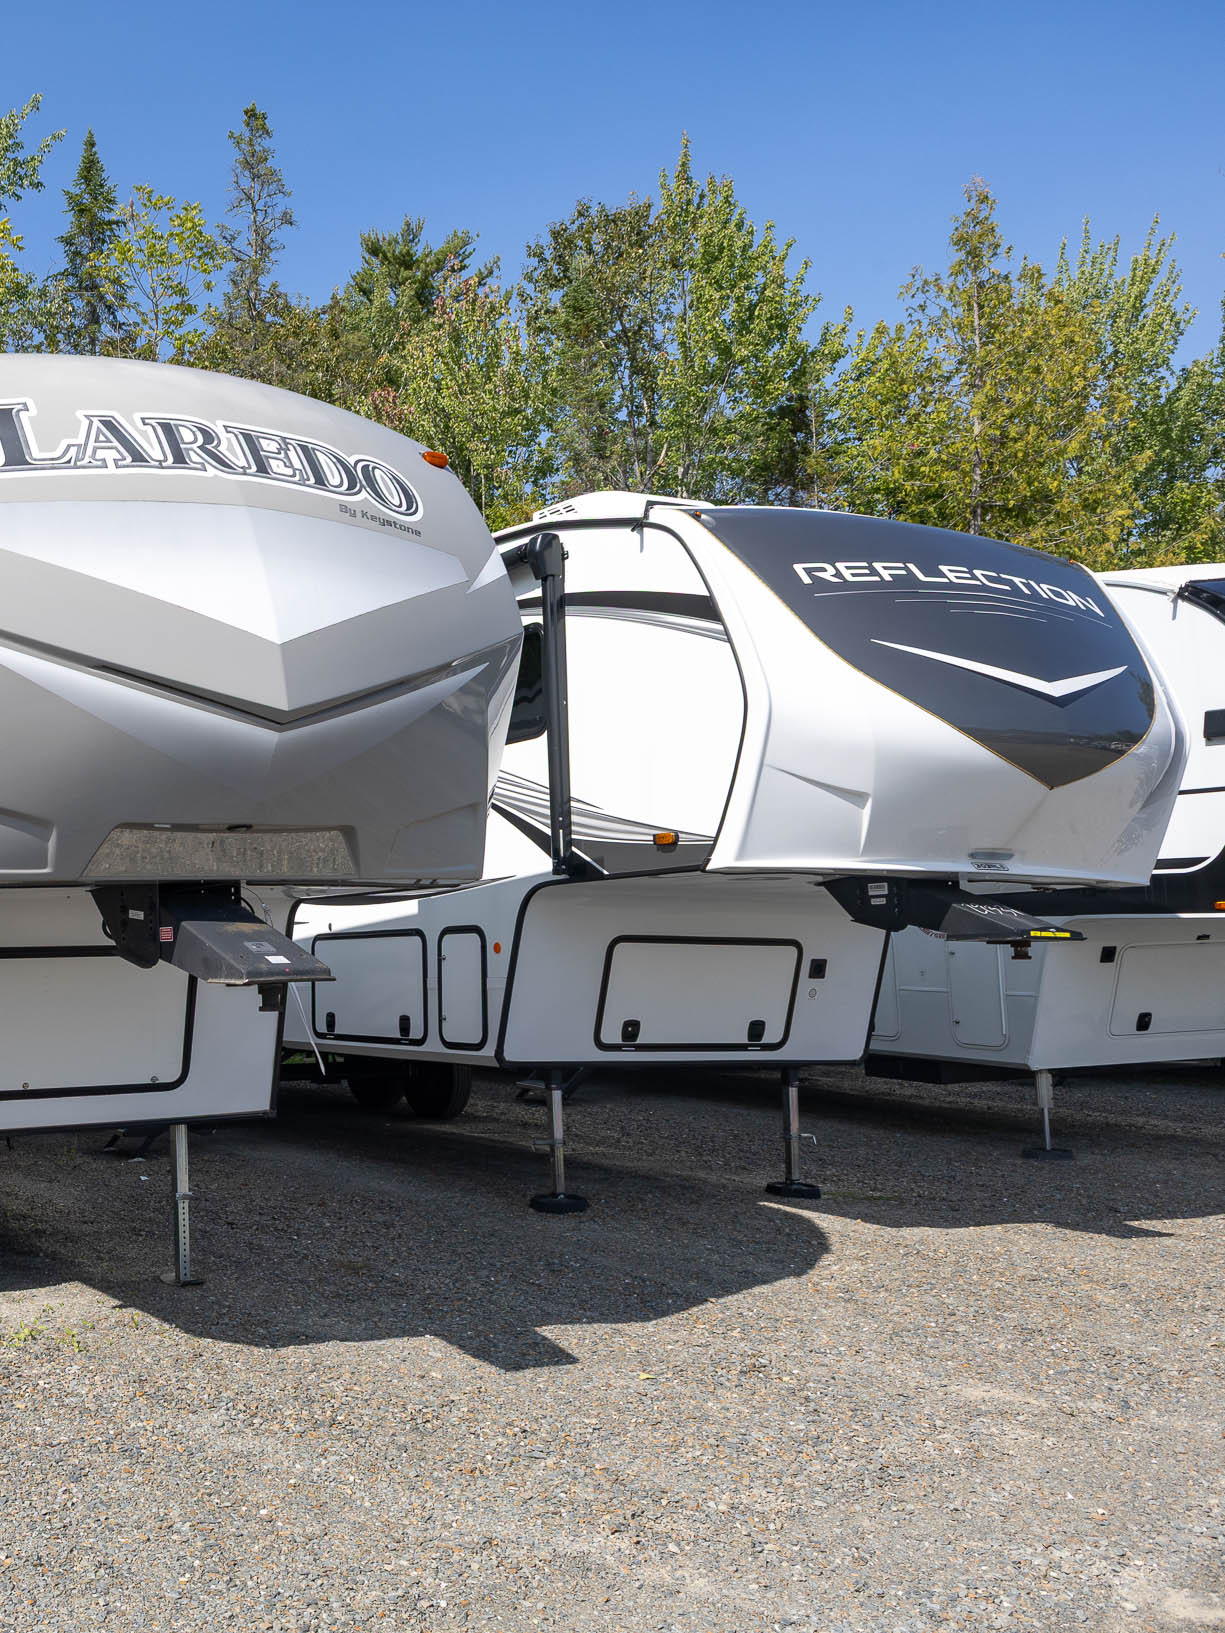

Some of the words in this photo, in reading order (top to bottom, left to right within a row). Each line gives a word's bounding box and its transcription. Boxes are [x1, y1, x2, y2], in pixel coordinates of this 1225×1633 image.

[339, 503, 357, 518] By
[361, 510, 422, 537] Keystone
[793, 562, 1105, 617] REFLECTION
